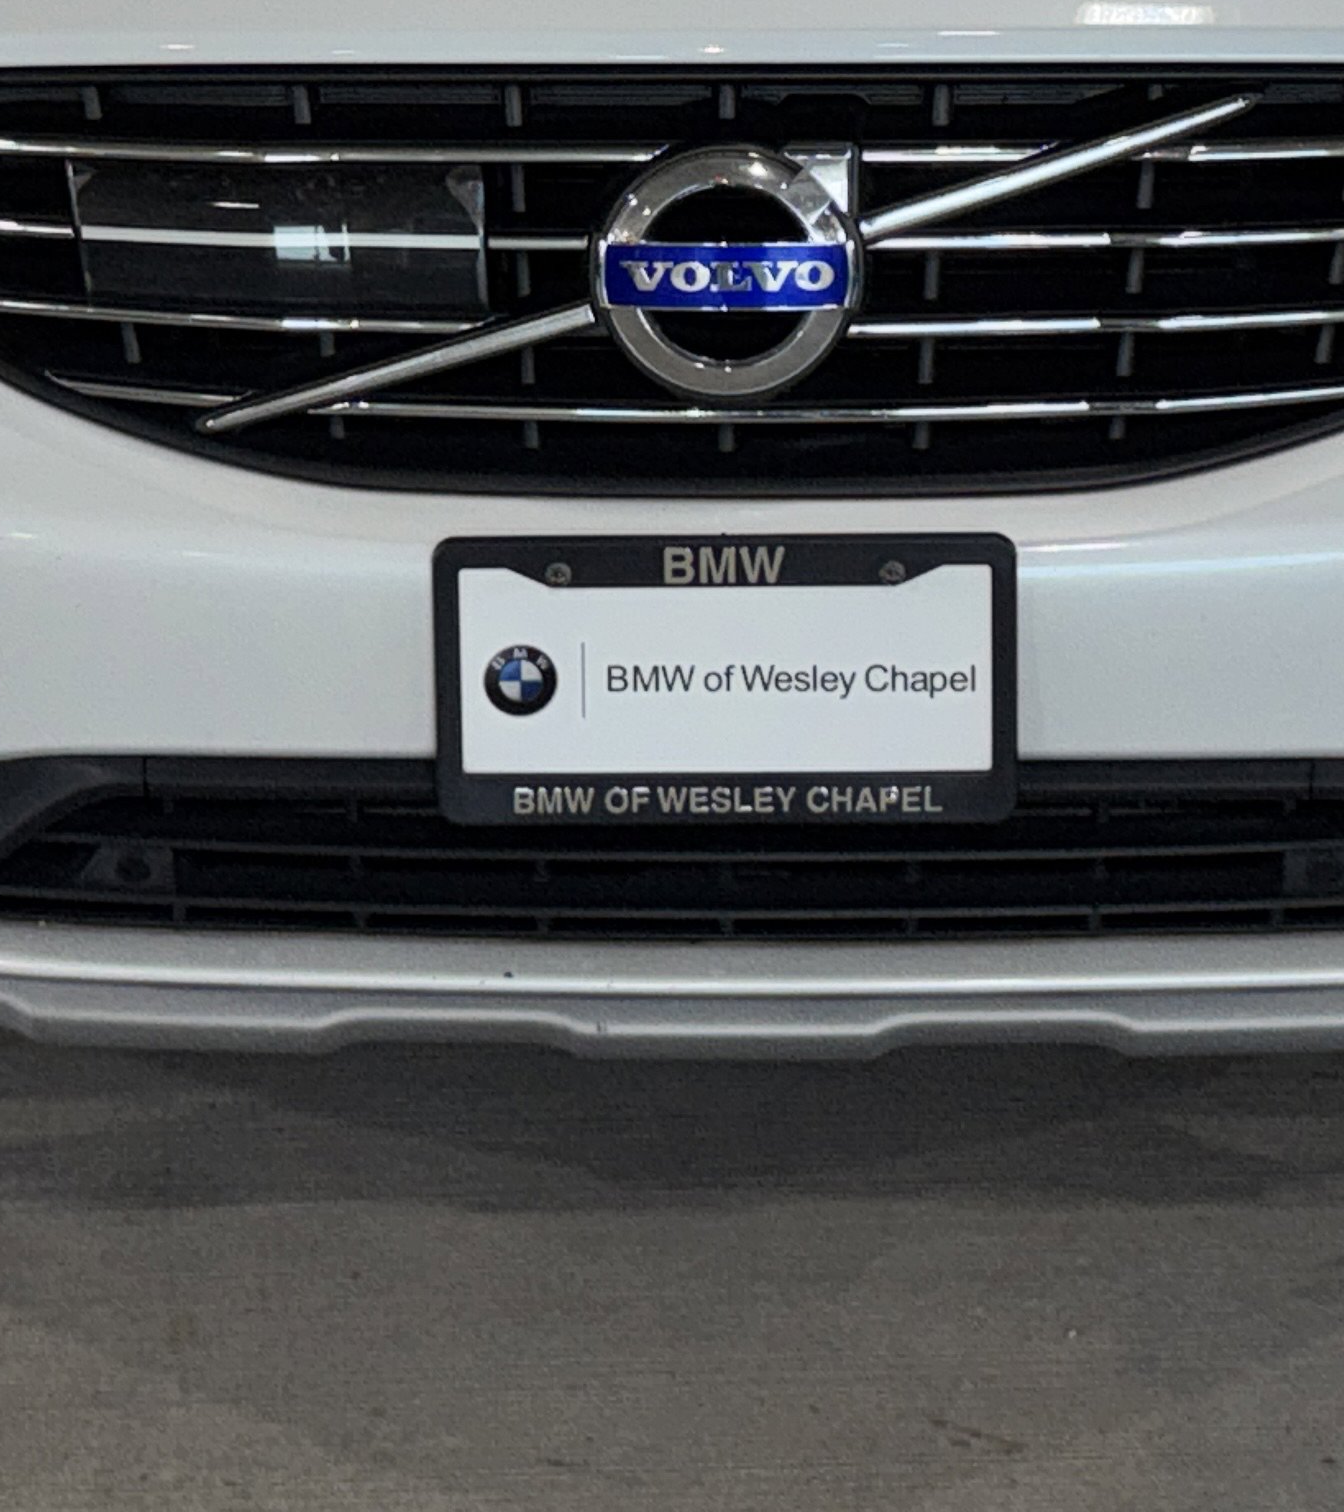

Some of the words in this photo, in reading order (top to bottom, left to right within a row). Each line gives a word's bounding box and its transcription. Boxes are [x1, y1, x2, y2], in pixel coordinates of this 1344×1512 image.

[620, 260, 835, 292] VOLVO
[663, 546, 785, 584] BMW
[607, 666, 694, 692] BMW
[703, 664, 734, 692] of
[741, 664, 856, 700] Wesley
[864, 664, 976, 699] Chapel
[513, 787, 594, 815] BMW
[605, 787, 650, 813] OF
[658, 787, 797, 813] WESLEY
[806, 786, 942, 813] CHAPEL
